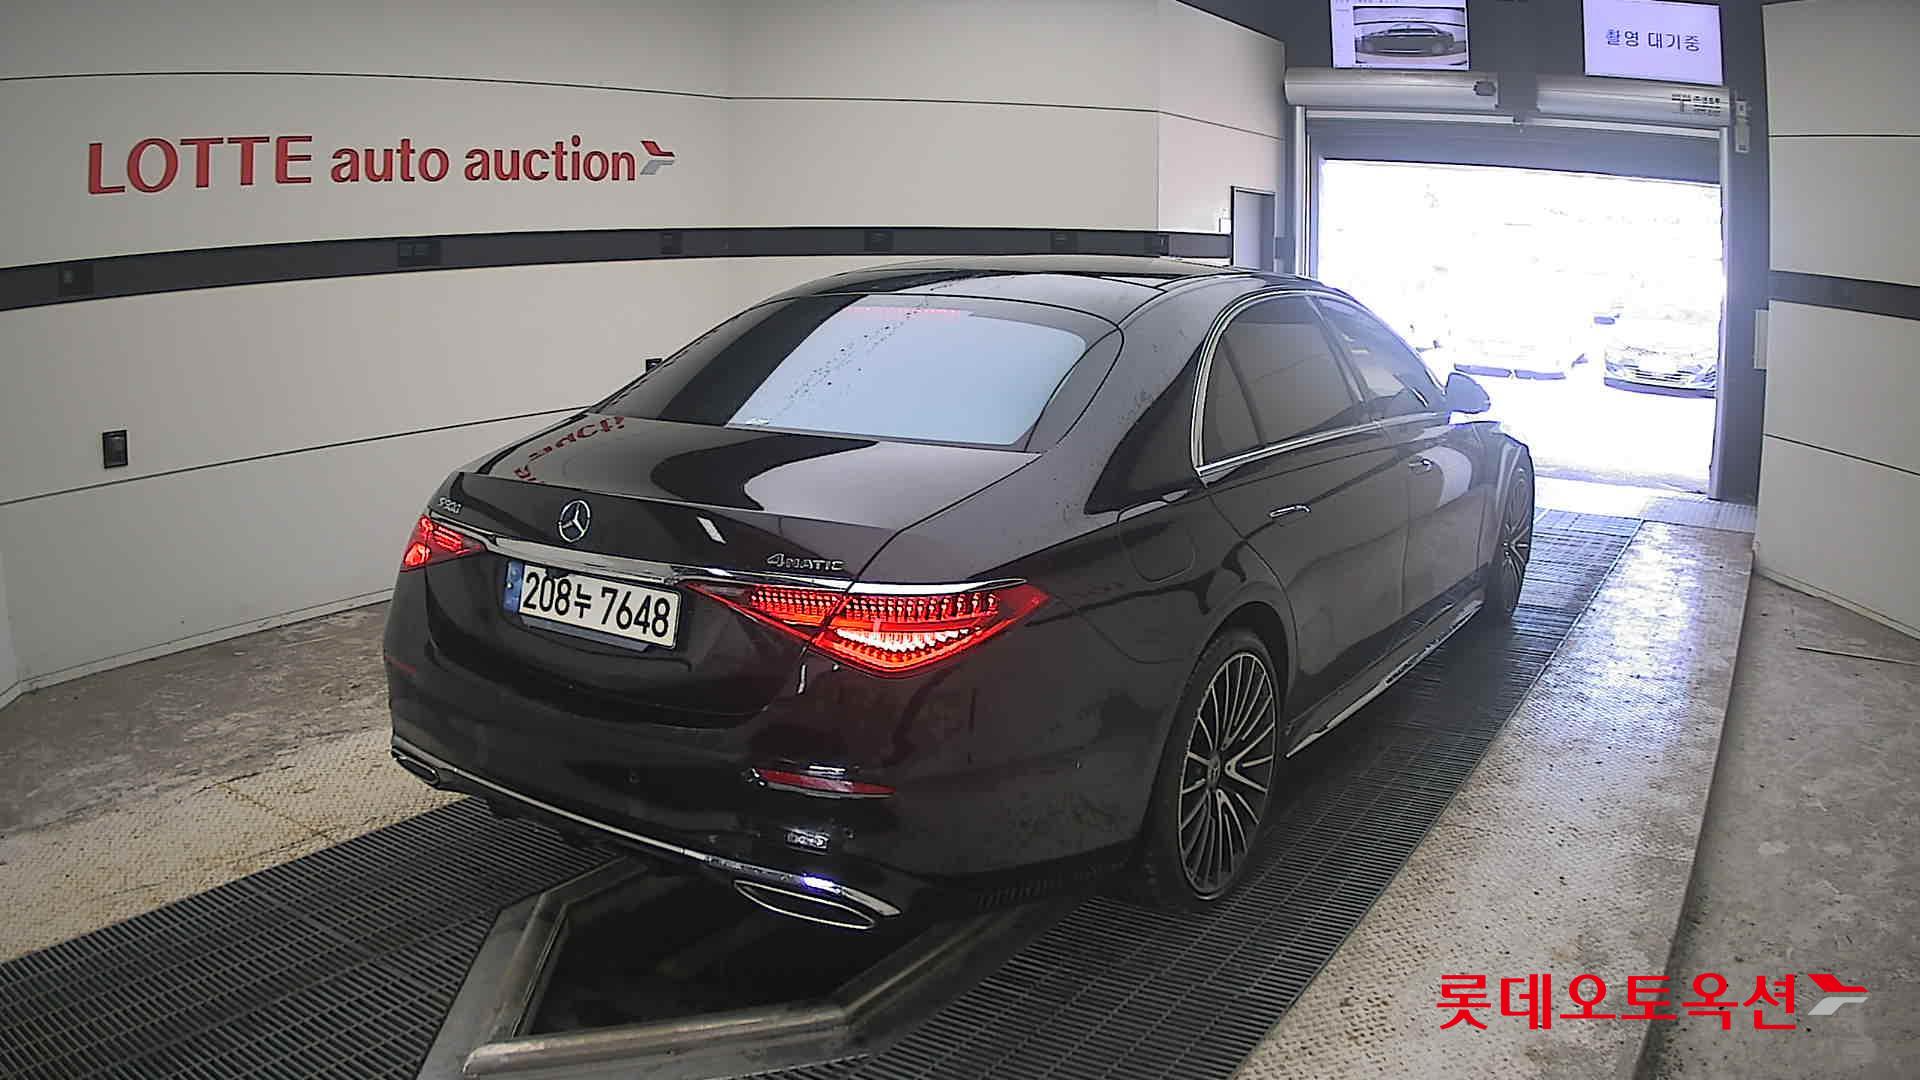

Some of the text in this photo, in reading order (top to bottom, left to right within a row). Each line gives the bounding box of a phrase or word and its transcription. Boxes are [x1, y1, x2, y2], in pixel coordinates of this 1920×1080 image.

[1606, 29, 1701, 53] 촬영 대기중
[88, 135, 636, 194] LOTTE auto auction
[767, 553, 845, 572] 4MATIC
[522, 572, 671, 638] 208누 7648
